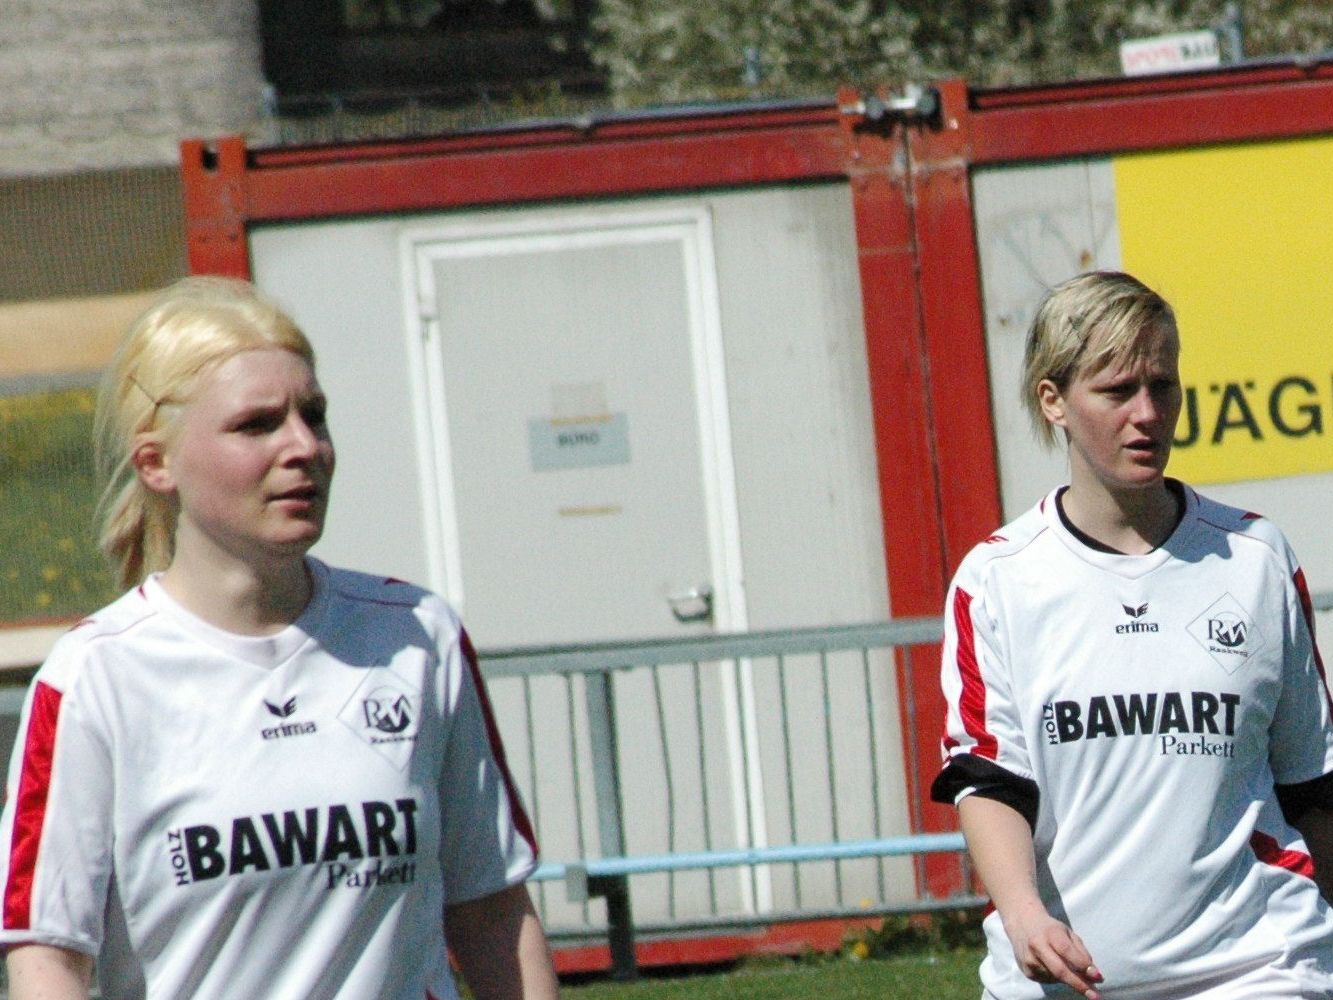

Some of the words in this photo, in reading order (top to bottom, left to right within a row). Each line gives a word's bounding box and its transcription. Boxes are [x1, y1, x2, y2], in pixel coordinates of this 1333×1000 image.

[1115, 619, 1159, 634] erima
[261, 720, 317, 740] erima
[1042, 702, 1059, 745] HOLZ
[1055, 691, 1240, 743] BAWART
[1161, 734, 1236, 758] Parkett
[168, 829, 190, 887] HOLZ
[185, 799, 417, 882] BAWART
[327, 859, 415, 890] Parkett
